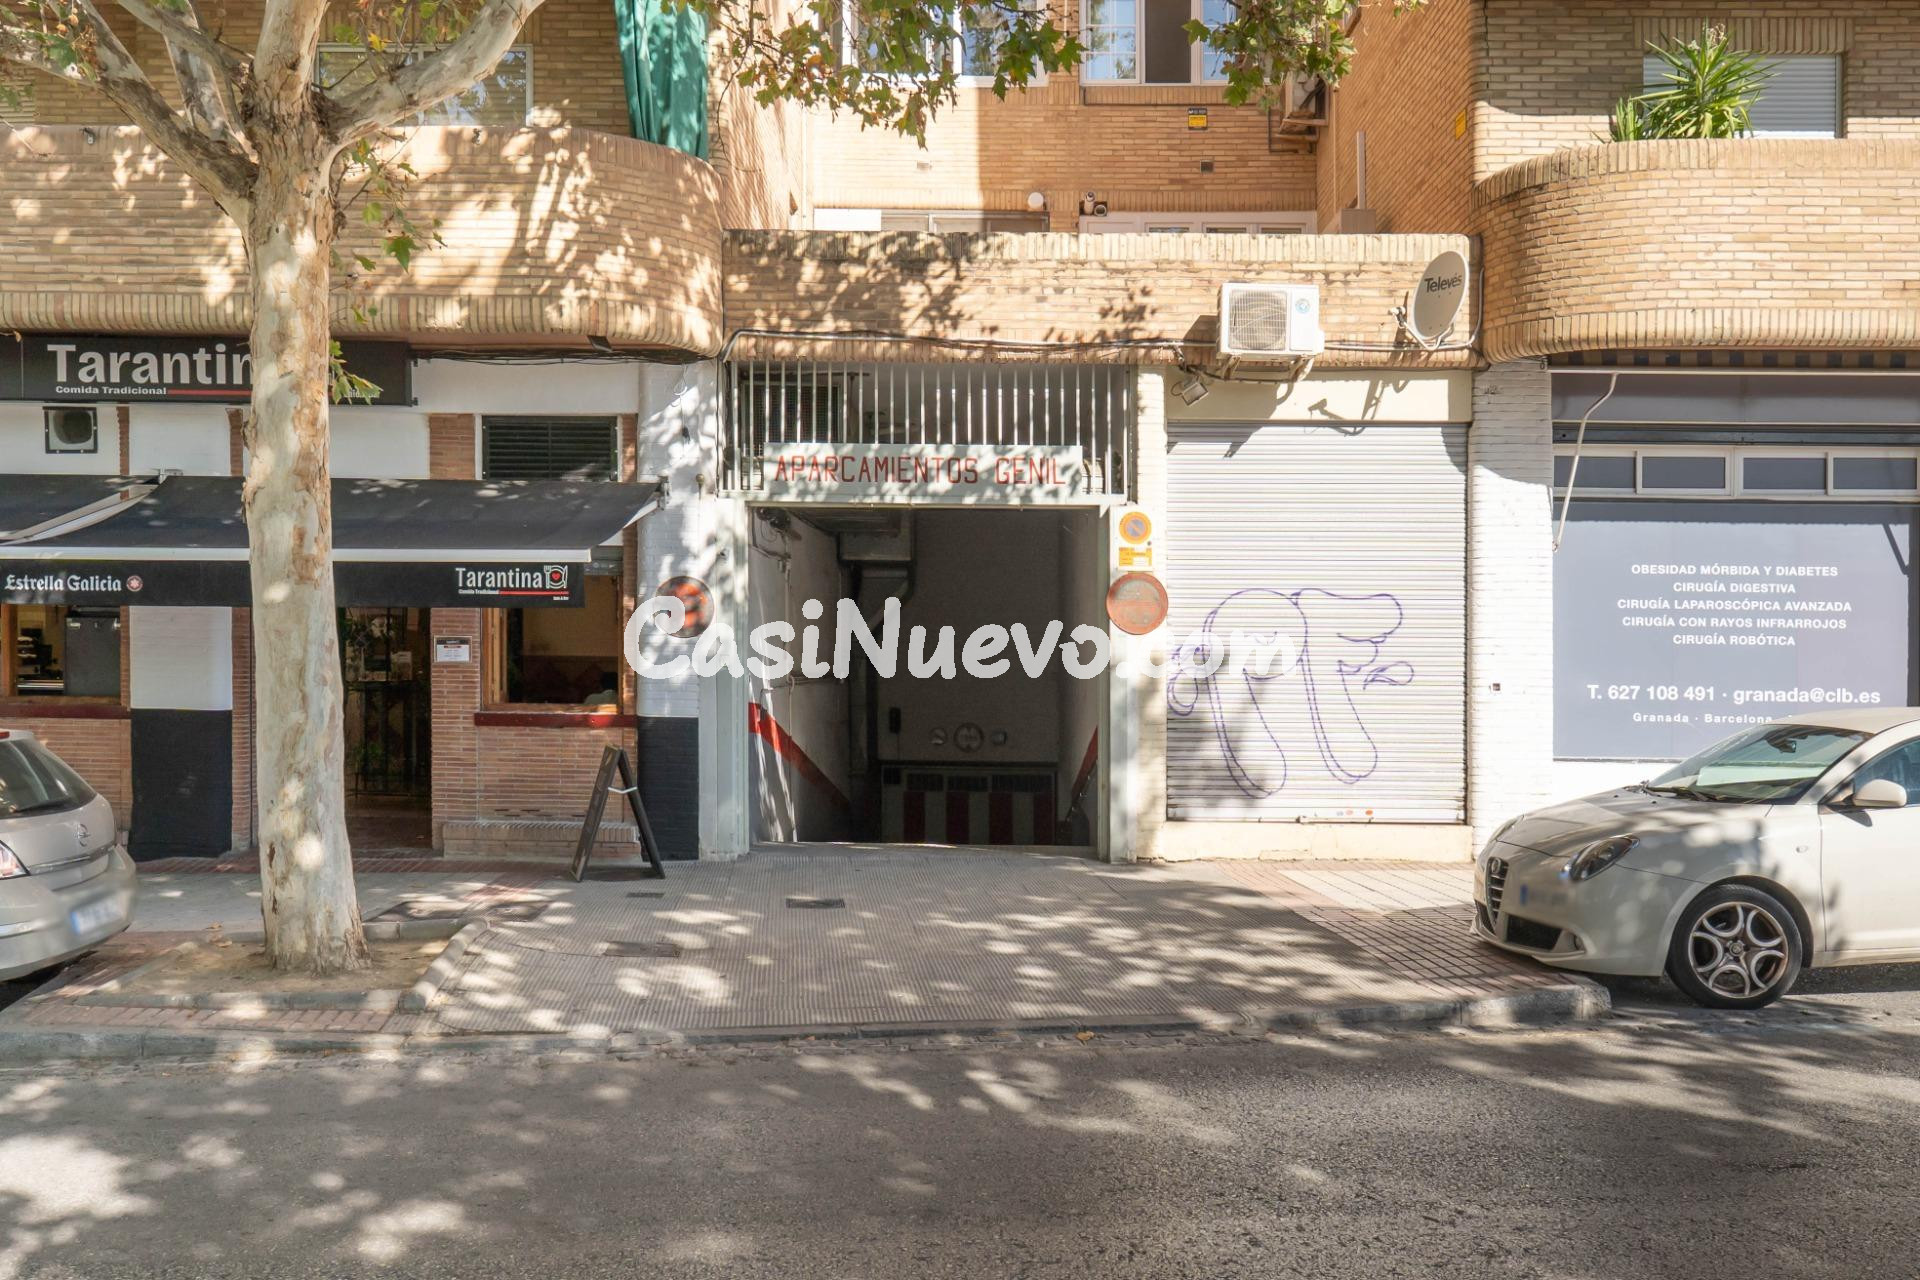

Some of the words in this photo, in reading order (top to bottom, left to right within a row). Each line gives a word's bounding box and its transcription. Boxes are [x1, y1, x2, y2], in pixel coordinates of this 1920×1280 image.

[47, 343, 252, 385] Tarantin
[55, 385, 99, 394] Comida
[102, 386, 167, 395] Tradicional
[774, 455, 979, 484] APARCAMIENTOS
[995, 456, 1066, 485] GENIL
[1631, 564, 1697, 575] OBESIDAD
[1700, 563, 1760, 576] MÓRBIDA
[1763, 566, 1772, 576] Y
[1776, 566, 1839, 577] DIABETES
[4, 574, 65, 591] Estrella
[67, 575, 122, 591] Galicia
[455, 567, 543, 589] Tarantina
[1673, 580, 1727, 593] CIRUGÍA
[1730, 583, 1796, 594] DIGESTIVA
[1617, 597, 1671, 610] CIRUGÍA
[1674, 598, 1781, 611] LAPAROSCÓPICA
[1784, 601, 1853, 612] AVANZADA
[1622, 614, 1676, 627] CIRUGÍA
[1679, 617, 1706, 628] CON
[1710, 618, 1753, 629] RAYOS
[1756, 618, 1847, 630] INFRARROJOS
[1672, 632, 1727, 645] CIRUGÍA
[1729, 633, 1796, 646] ROBÓTICA
[1587, 684, 1603, 700] T.
[1607, 685, 1641, 700] 627
[1646, 685, 1679, 700] 108
[1683, 686, 1715, 701] 491
[1733, 687, 1881, 705] granada@clb.es
[1632, 712, 1689, 723] Granada
